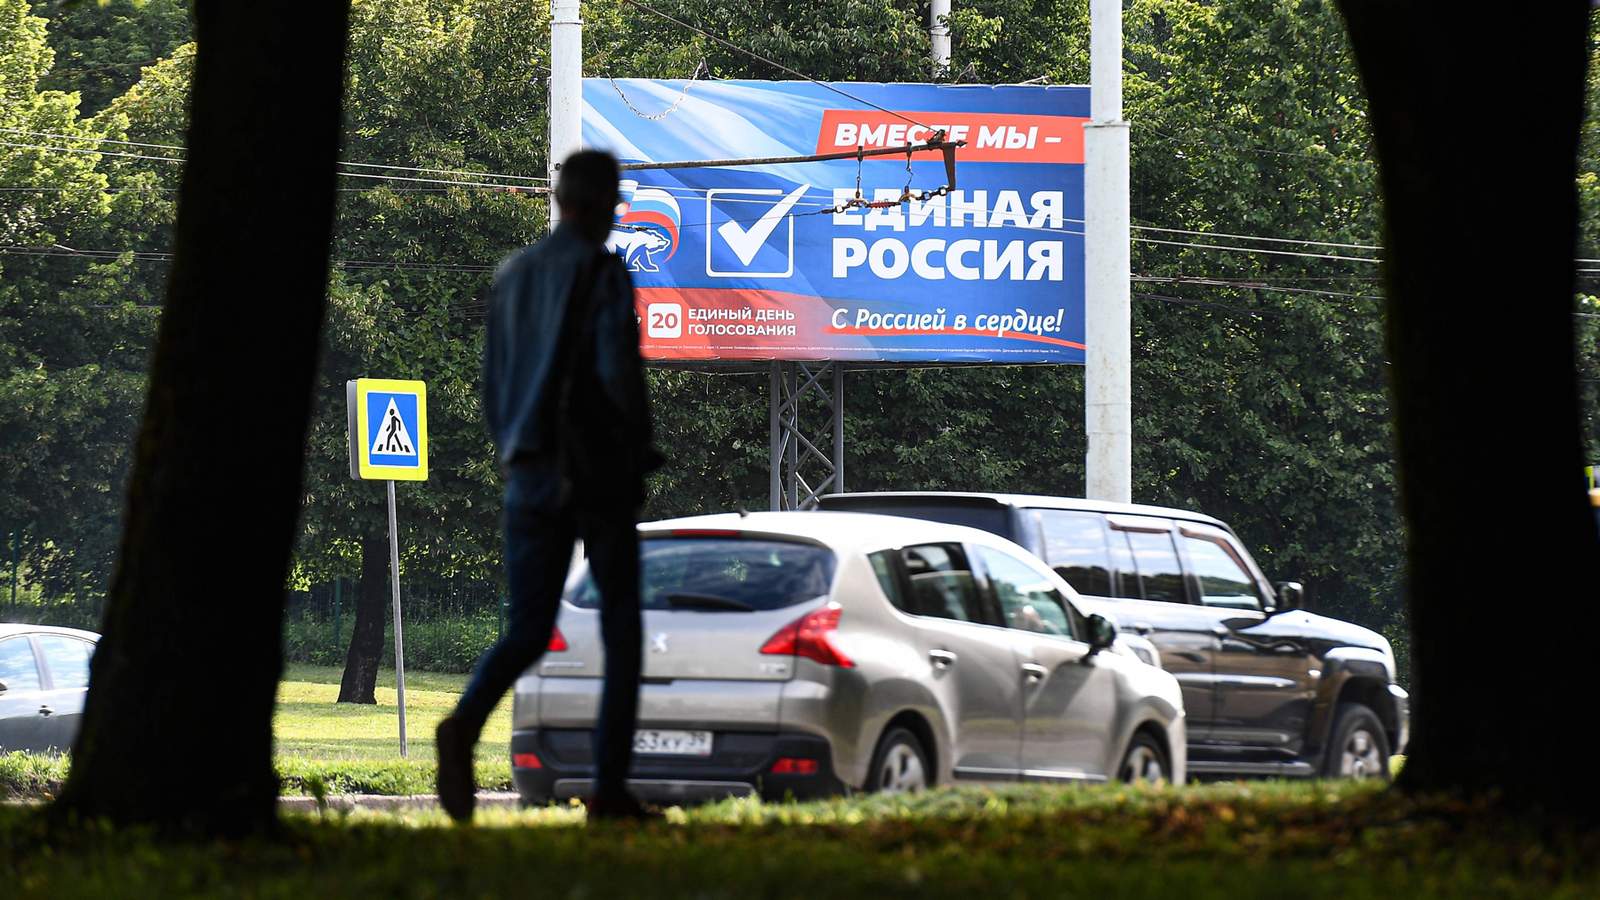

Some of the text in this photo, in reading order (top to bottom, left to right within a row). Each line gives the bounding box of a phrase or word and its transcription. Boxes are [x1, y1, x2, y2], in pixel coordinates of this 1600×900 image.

[976, 125, 1039, 150] МЫ
[832, 187, 1064, 232] ЕДИНАЯ
[832, 237, 1064, 281] РОССИЯ
[652, 313, 678, 329] 20
[688, 307, 795, 322] ЕДИНЫЙ ДЕНЬ
[831, 307, 1065, 337] С Россией в сердце!
[688, 324, 796, 336] ГОЛОСОВАНИЯ
